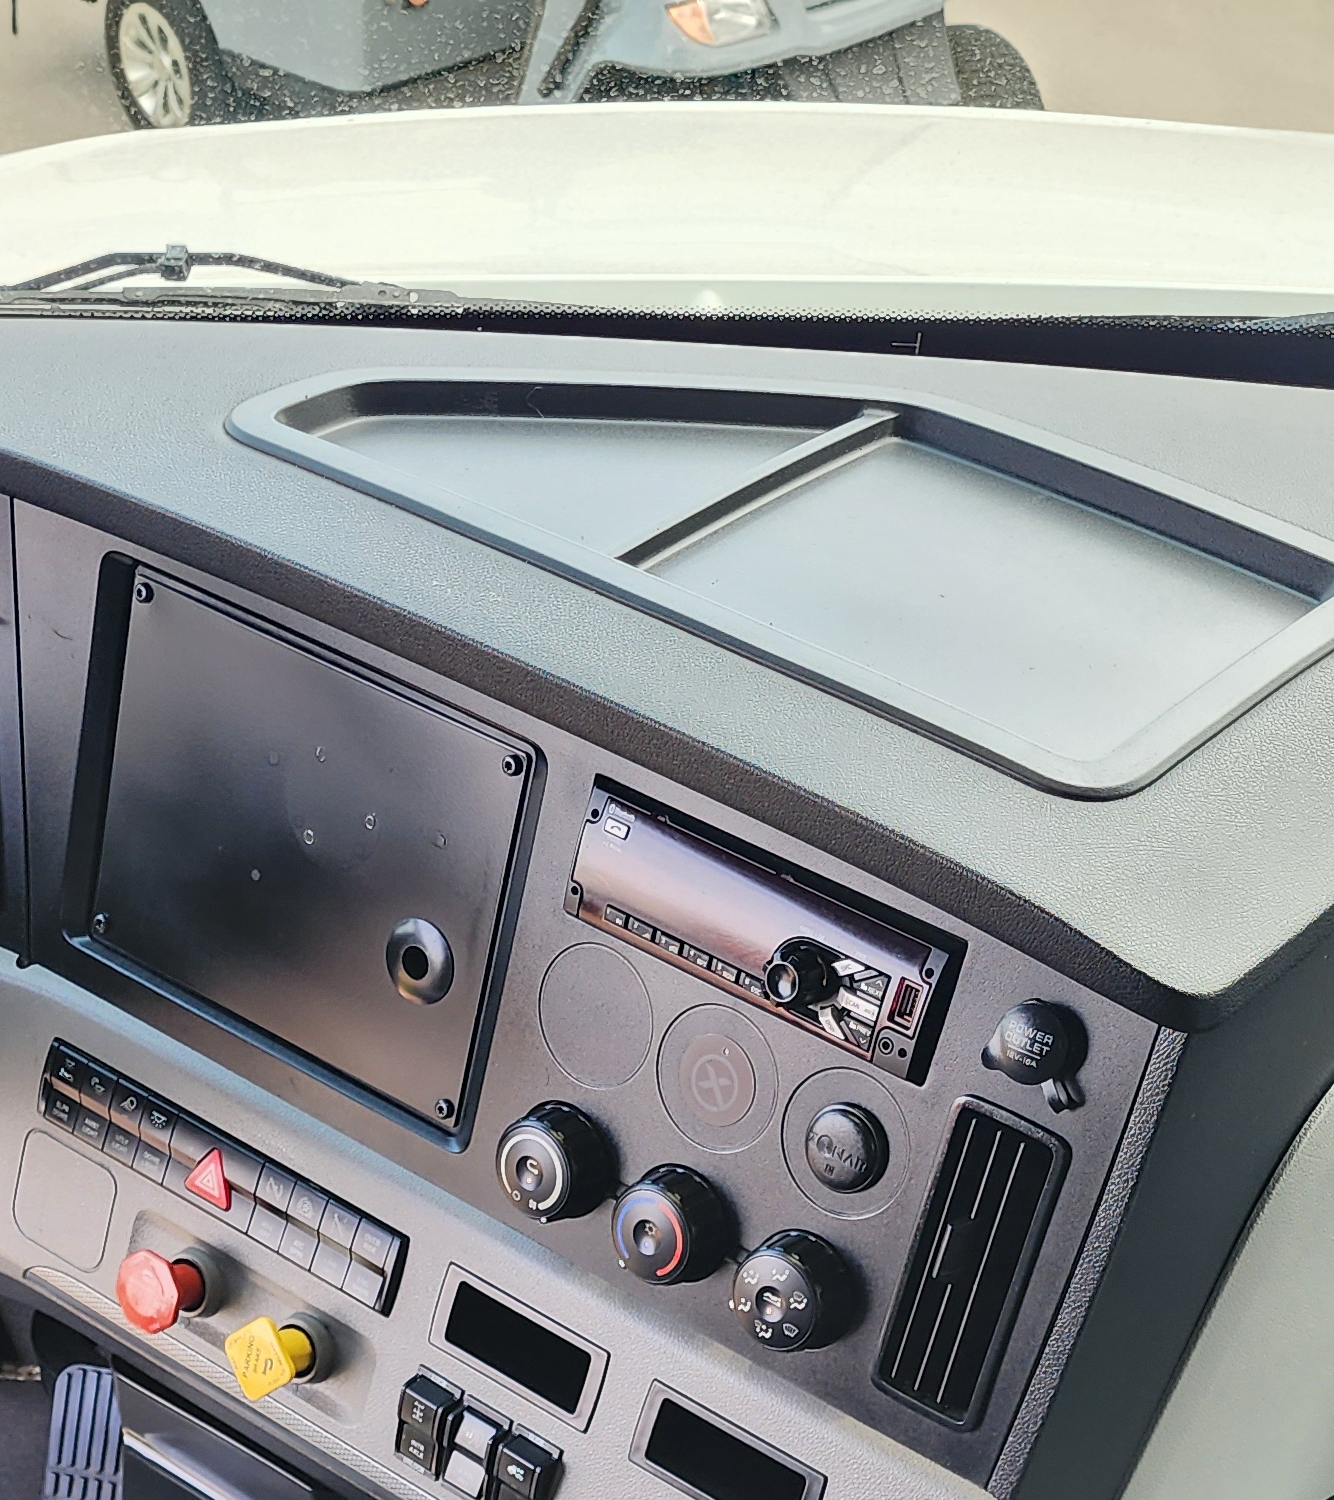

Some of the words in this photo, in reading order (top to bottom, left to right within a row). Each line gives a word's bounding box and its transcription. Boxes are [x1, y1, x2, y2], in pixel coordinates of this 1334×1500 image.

[1005, 1031, 1051, 1056] OUTLET
[1008, 1020, 1054, 1046] POWER
[242, 1335, 255, 1378] PARKING
